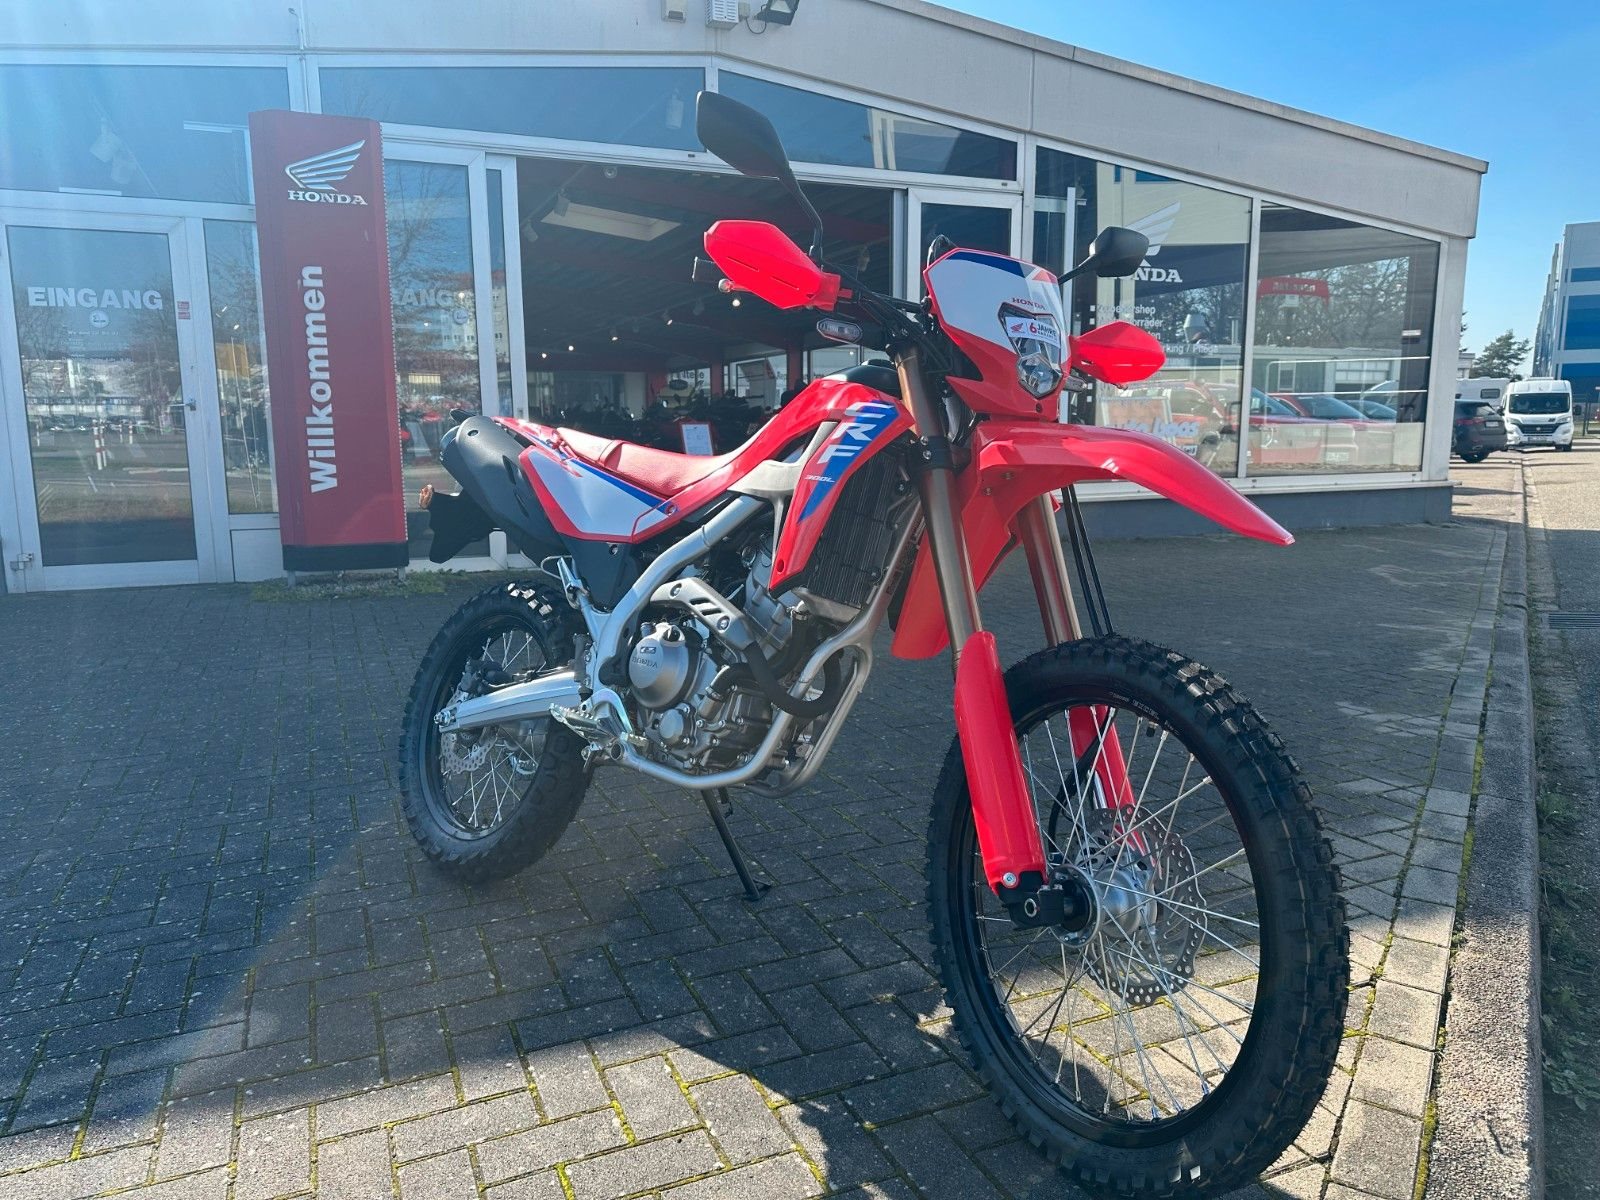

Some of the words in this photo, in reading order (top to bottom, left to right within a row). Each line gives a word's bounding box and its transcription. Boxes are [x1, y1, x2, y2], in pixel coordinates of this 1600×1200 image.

[287, 189, 368, 206] HONDA
[27, 286, 164, 310] EINGANG
[1012, 297, 1046, 310] HONDA
[1029, 322, 1038, 334] 6
[301, 265, 338, 494] Willkommen
[816, 401, 896, 465] CRF
[804, 474, 836, 483] 300L
